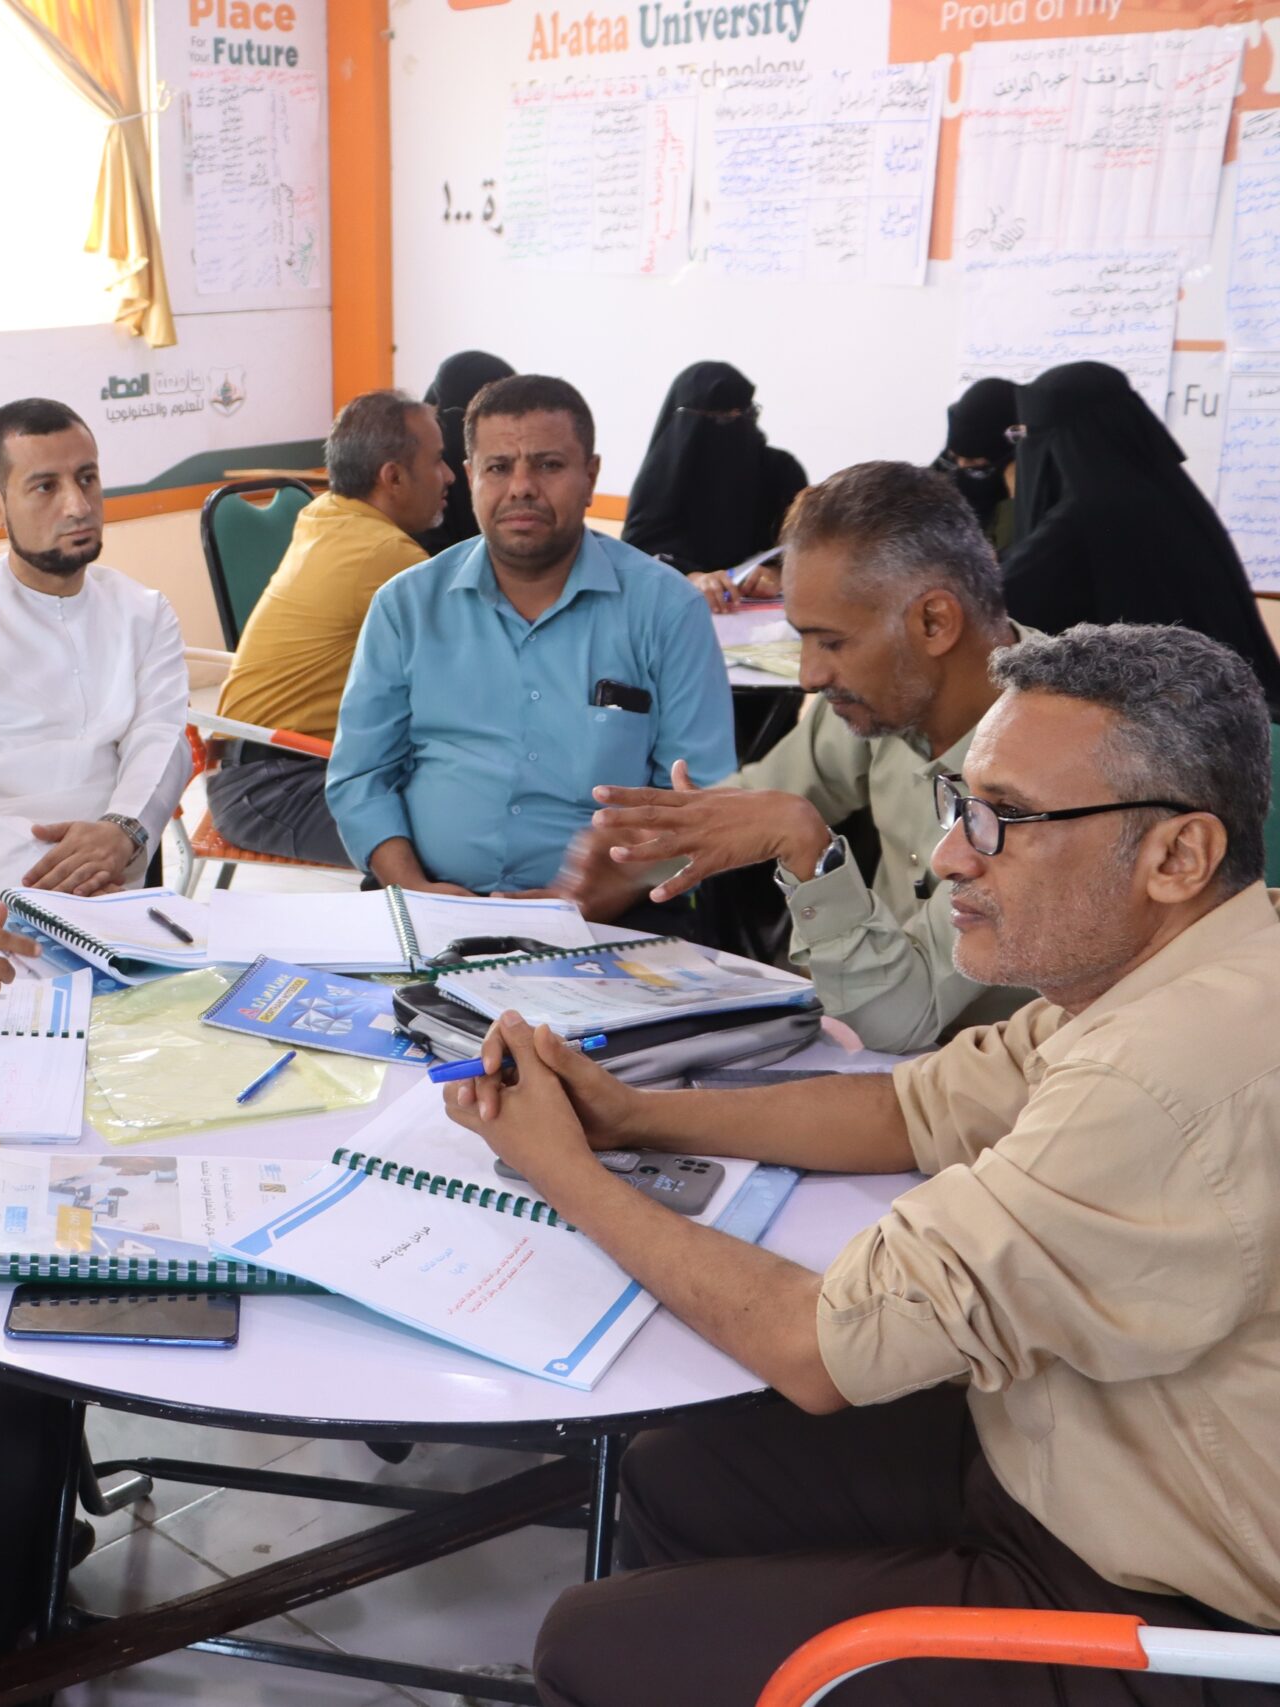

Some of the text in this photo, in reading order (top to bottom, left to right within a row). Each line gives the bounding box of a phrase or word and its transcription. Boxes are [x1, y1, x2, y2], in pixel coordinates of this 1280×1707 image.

[188, 0, 297, 32] Place
[528, 0, 808, 61] Al-ataa University
[940, 0, 1026, 31] Proud
[213, 37, 299, 67] Future
[677, 56, 805, 88] Tchnology
[101, 373, 150, 400] العطاء
[106, 400, 168, 423] والتكنولوجيا
